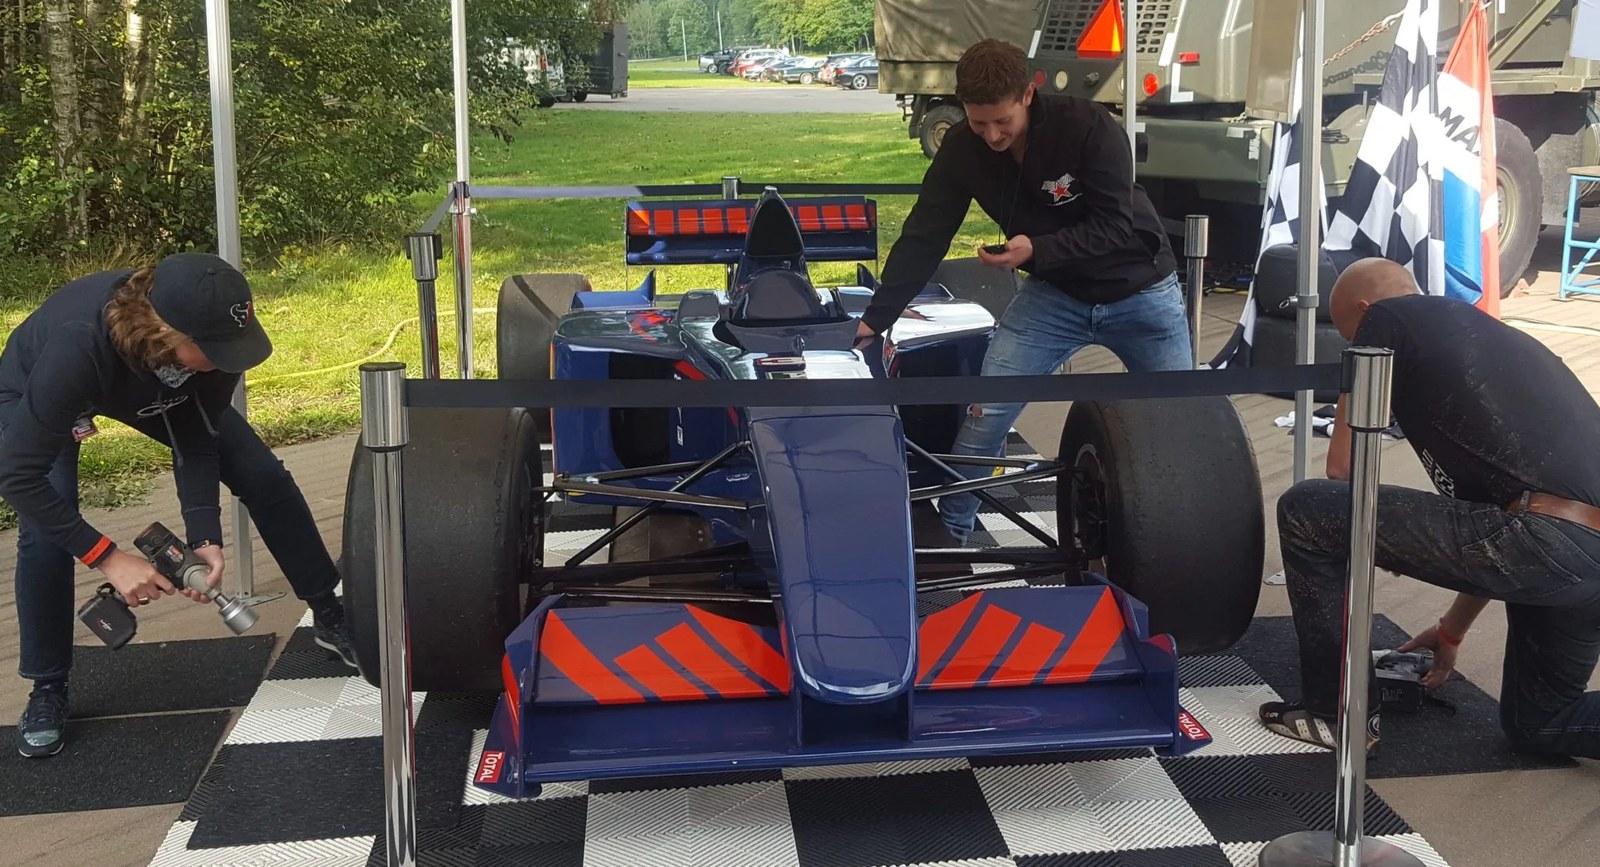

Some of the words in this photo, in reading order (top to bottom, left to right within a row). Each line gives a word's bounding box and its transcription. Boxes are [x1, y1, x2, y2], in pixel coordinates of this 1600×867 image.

[1439, 106, 1480, 156] MA
[1179, 713, 1204, 739] TOTAL
[480, 752, 503, 781] TOTAL
